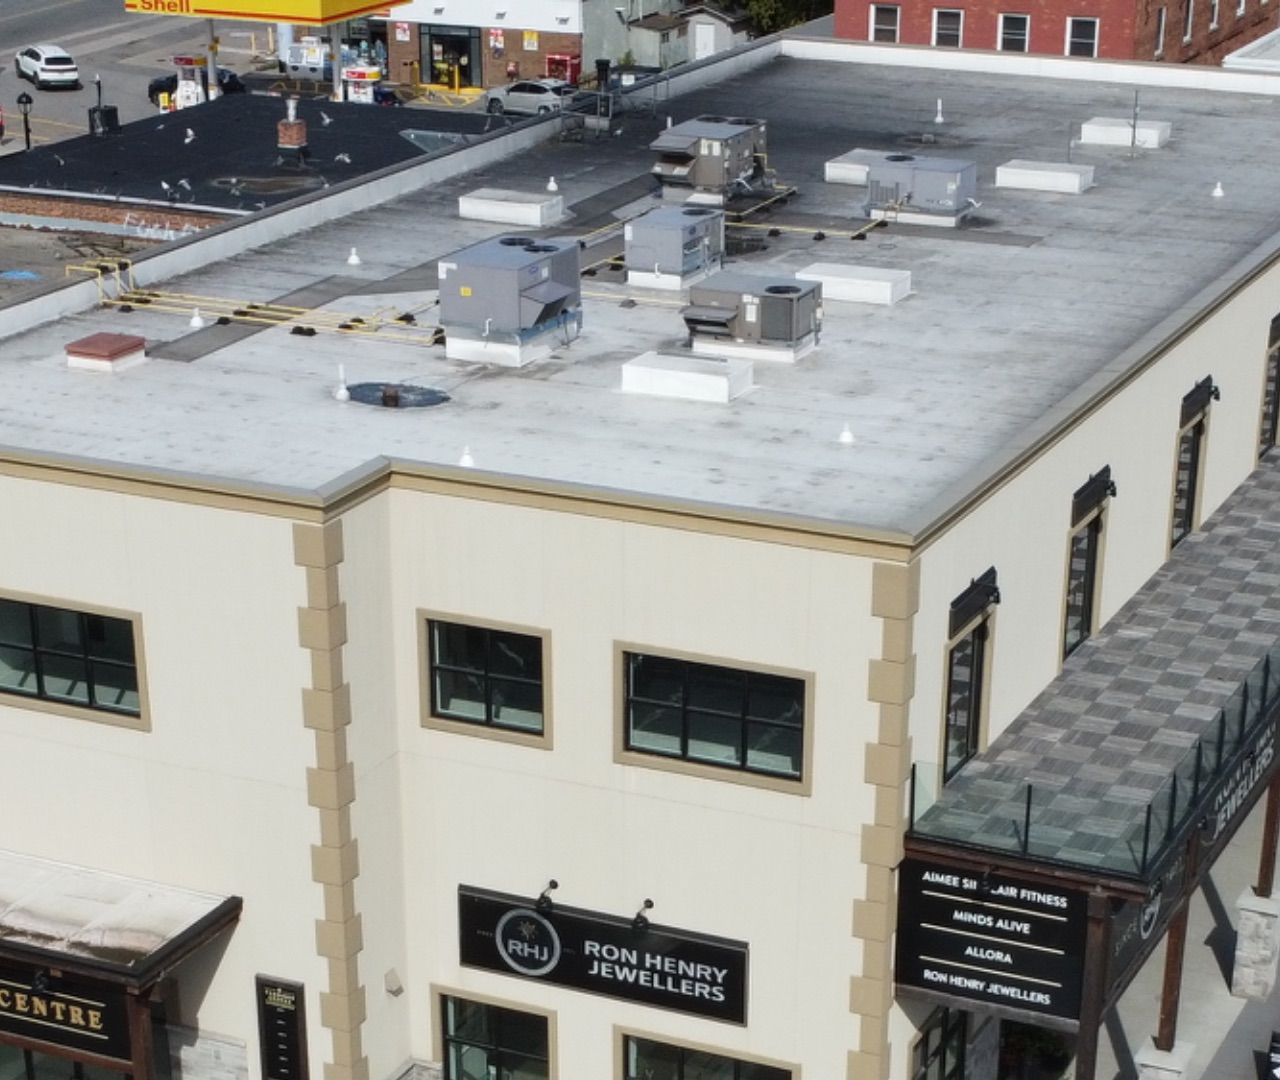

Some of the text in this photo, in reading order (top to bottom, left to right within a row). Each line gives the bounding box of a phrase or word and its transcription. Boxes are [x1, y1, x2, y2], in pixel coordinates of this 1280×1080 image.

[921, 870, 960, 888] AIMEE
[1019, 888, 1069, 909] FITNESS
[952, 909, 1032, 935] MINDS ALIVE
[506, 938, 549, 962] RHJ
[583, 939, 730, 985] RON HENRY
[964, 945, 1013, 965] ALLORA
[587, 959, 726, 1003] JEWELLERS
[923, 968, 1052, 1006] RON HENRY JEWELLERS
